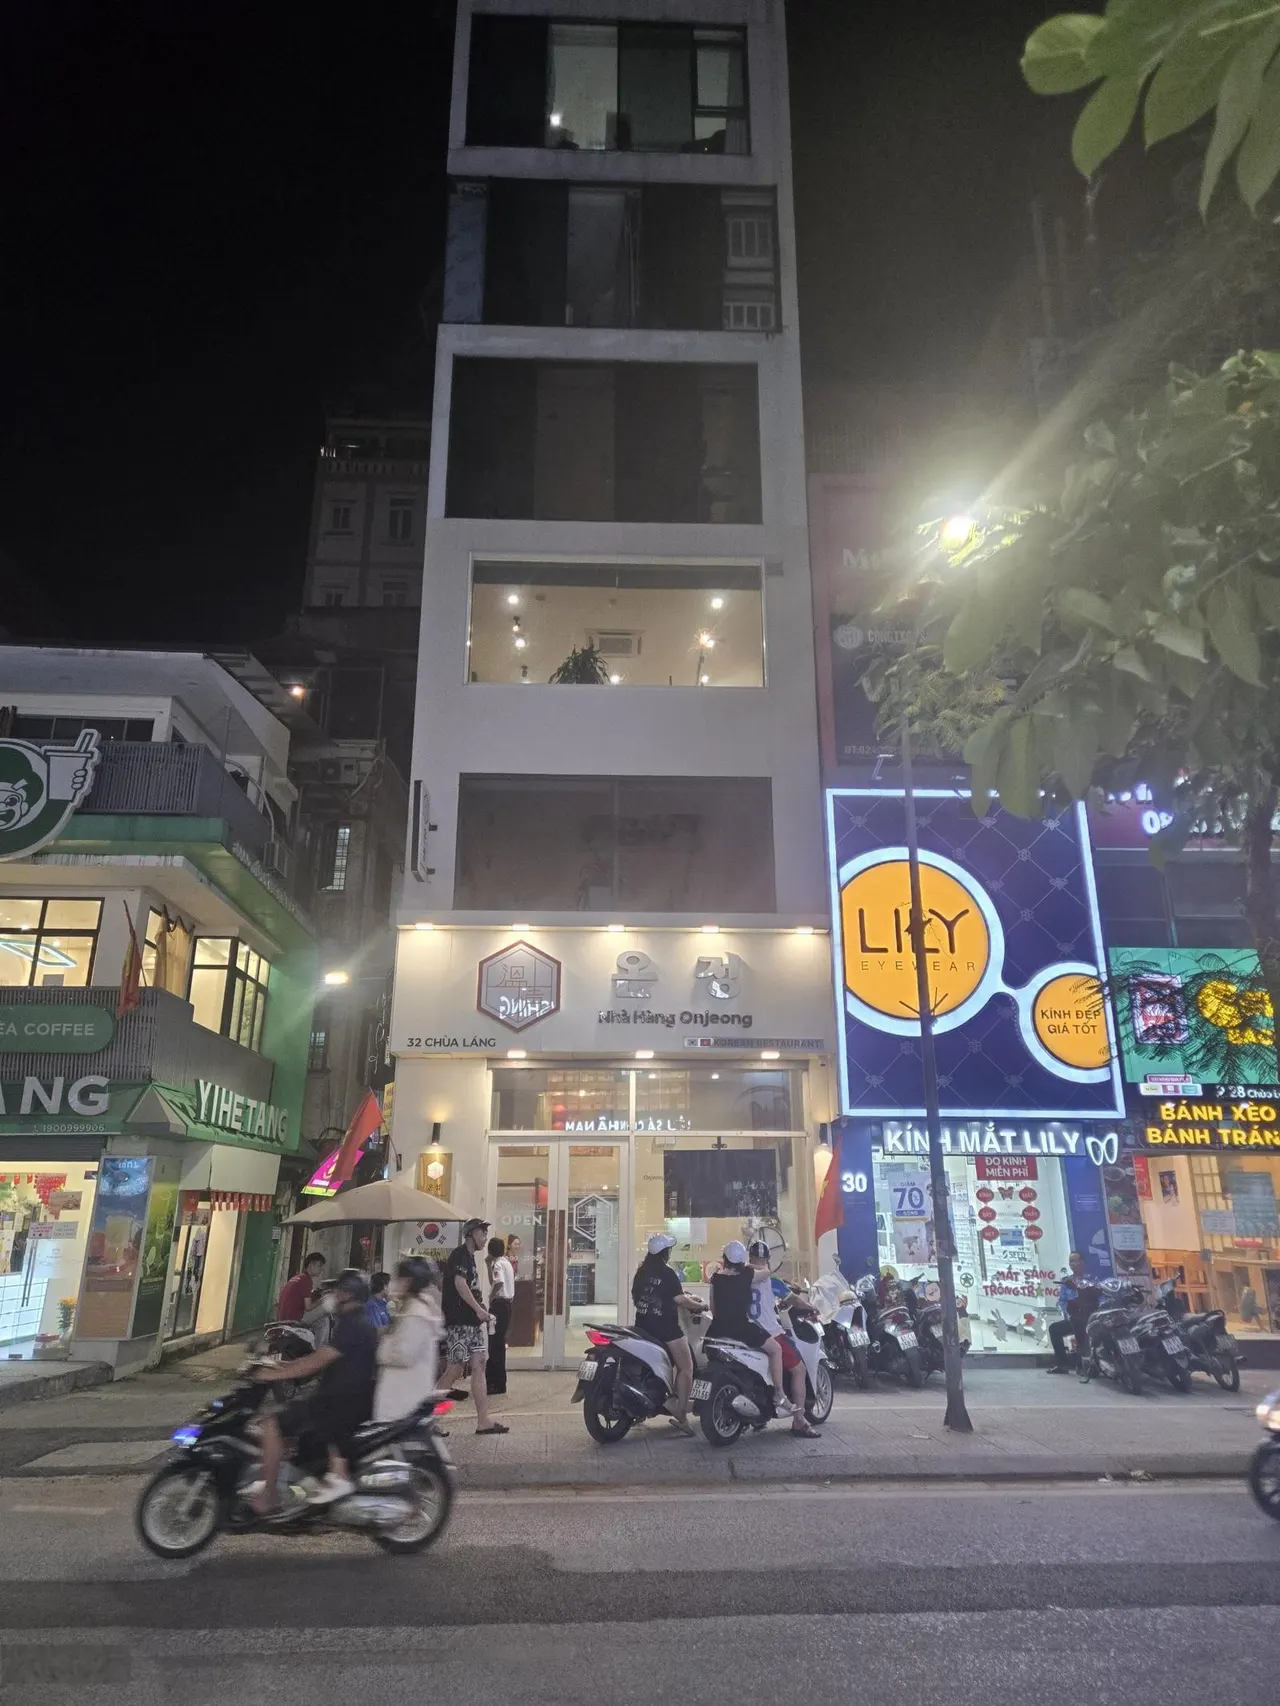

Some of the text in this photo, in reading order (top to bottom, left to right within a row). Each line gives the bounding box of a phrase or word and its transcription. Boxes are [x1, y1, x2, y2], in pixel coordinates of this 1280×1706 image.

[861, 960, 976, 972] EYEEAR
[680, 1010, 753, 1028] Onjeong
[1041, 1007, 1101, 1021] KÍNH ĐẸP
[24, 1023, 95, 1036] COFFEE
[1047, 1021, 1098, 1034] GIÁ TỐT
[407, 1037, 422, 1047] 32
[462, 1035, 497, 1047] LÁNG
[713, 1038, 822, 1049] KOREAN RESTAURANT
[0, 1075, 110, 1116] NG
[198, 1078, 288, 1142] YIHETANG
[1160, 1099, 1277, 1122] BÁNH XÈO
[960, 1120, 1017, 1153] MẮT
[1023, 1131, 1080, 1154] LILY
[1146, 1123, 1211, 1145] BÁNH
[842, 1172, 867, 1193] 30
[502, 1214, 543, 1227] OPEN
[1021, 1285, 1060, 1298] TRNG
